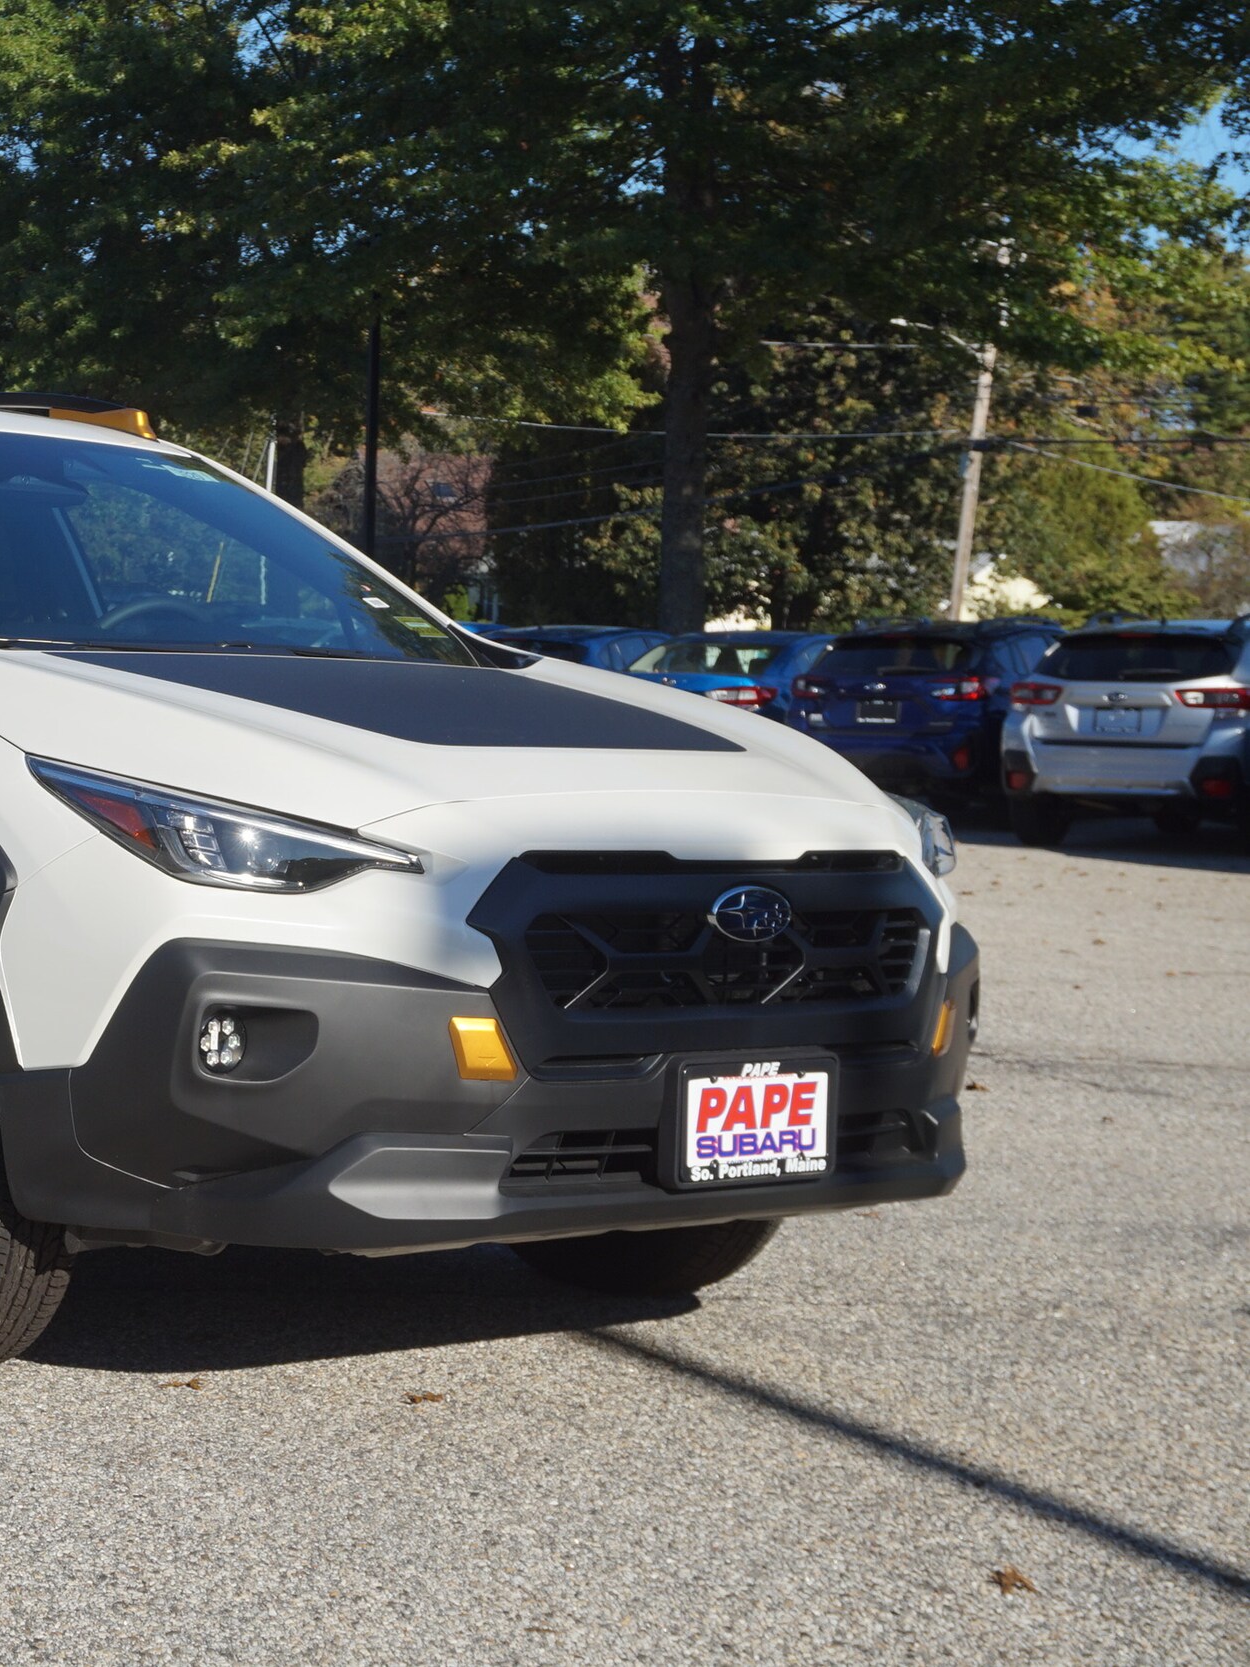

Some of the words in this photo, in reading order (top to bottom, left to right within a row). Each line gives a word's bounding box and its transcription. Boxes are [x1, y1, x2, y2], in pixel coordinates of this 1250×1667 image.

[741, 1062, 781, 1077] PAPE
[696, 1081, 818, 1133] PAPE
[696, 1128, 817, 1159] SUBARU
[691, 1166, 714, 1182] So.
[718, 1160, 781, 1179] Portland,
[785, 1156, 827, 1173] Maine
